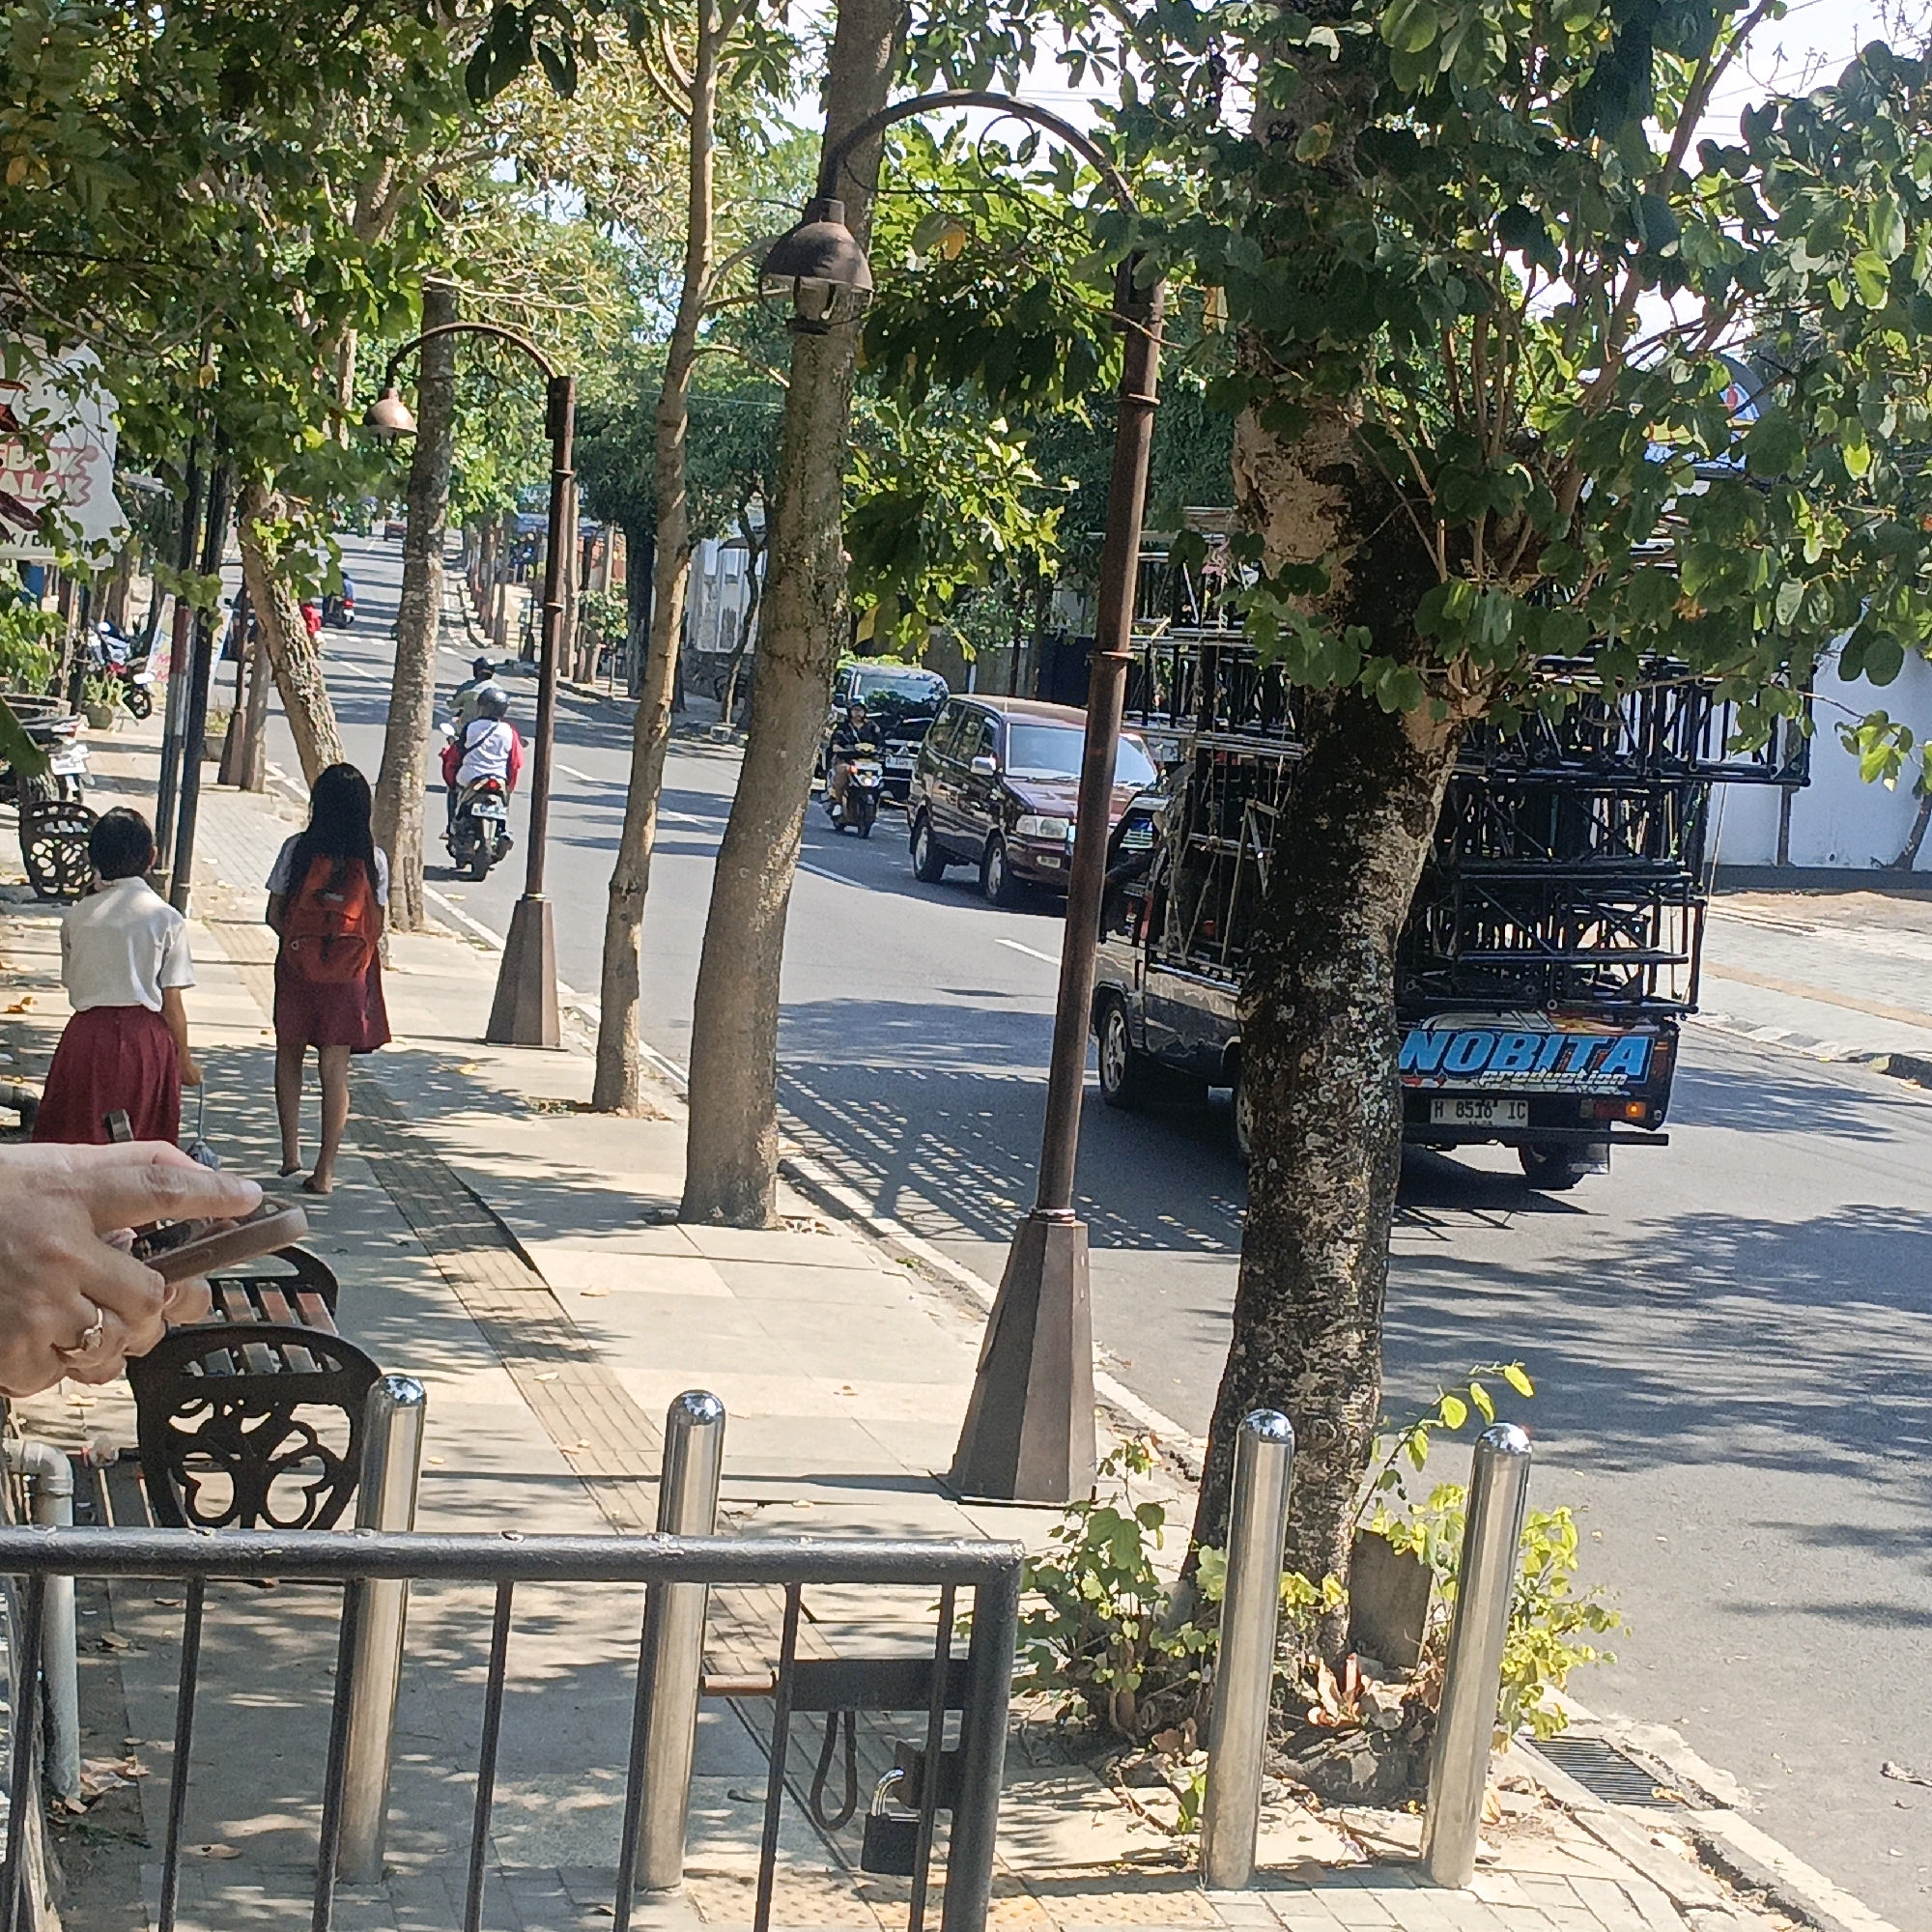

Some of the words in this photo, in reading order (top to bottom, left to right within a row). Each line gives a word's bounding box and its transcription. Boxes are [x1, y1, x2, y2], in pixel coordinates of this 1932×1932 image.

[1399, 1030, 1651, 1075] NOBITA
[1479, 1067, 1629, 1086] production
[1435, 1101, 1444, 1119] H
[1507, 1102, 1526, 1120] IC
